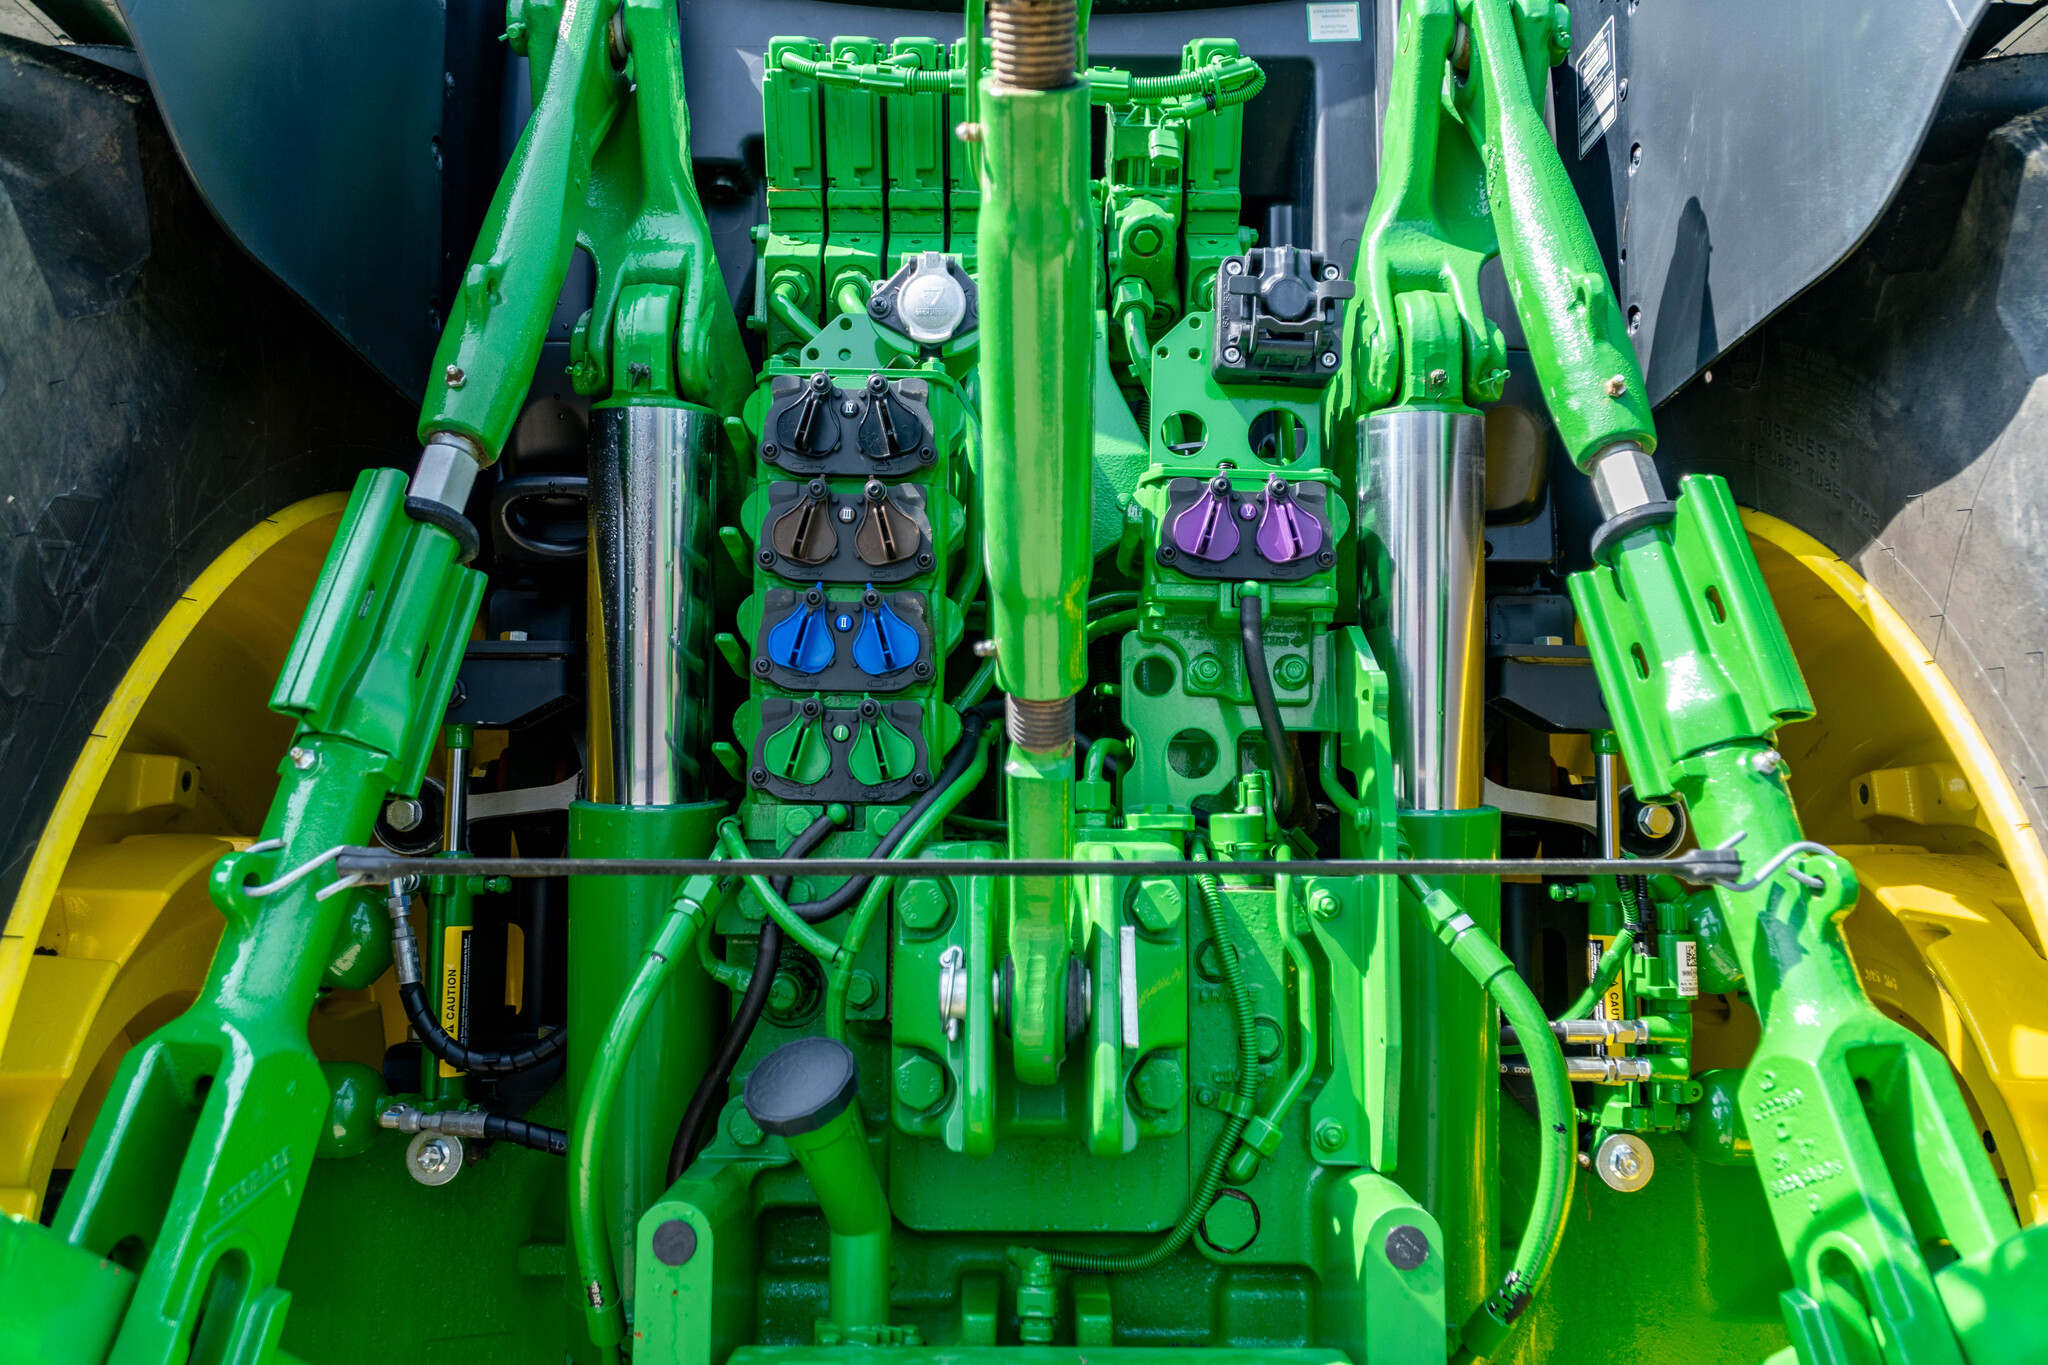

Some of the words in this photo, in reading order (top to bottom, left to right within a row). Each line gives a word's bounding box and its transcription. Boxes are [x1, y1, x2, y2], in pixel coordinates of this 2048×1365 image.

[845, 402, 854, 413] IV
[1808, 467, 1841, 499] TUBE
[843, 509, 852, 519] III
[1244, 505, 1253, 517] V
[840, 617, 847, 628] II
[446, 969, 456, 1019] CAUTION
